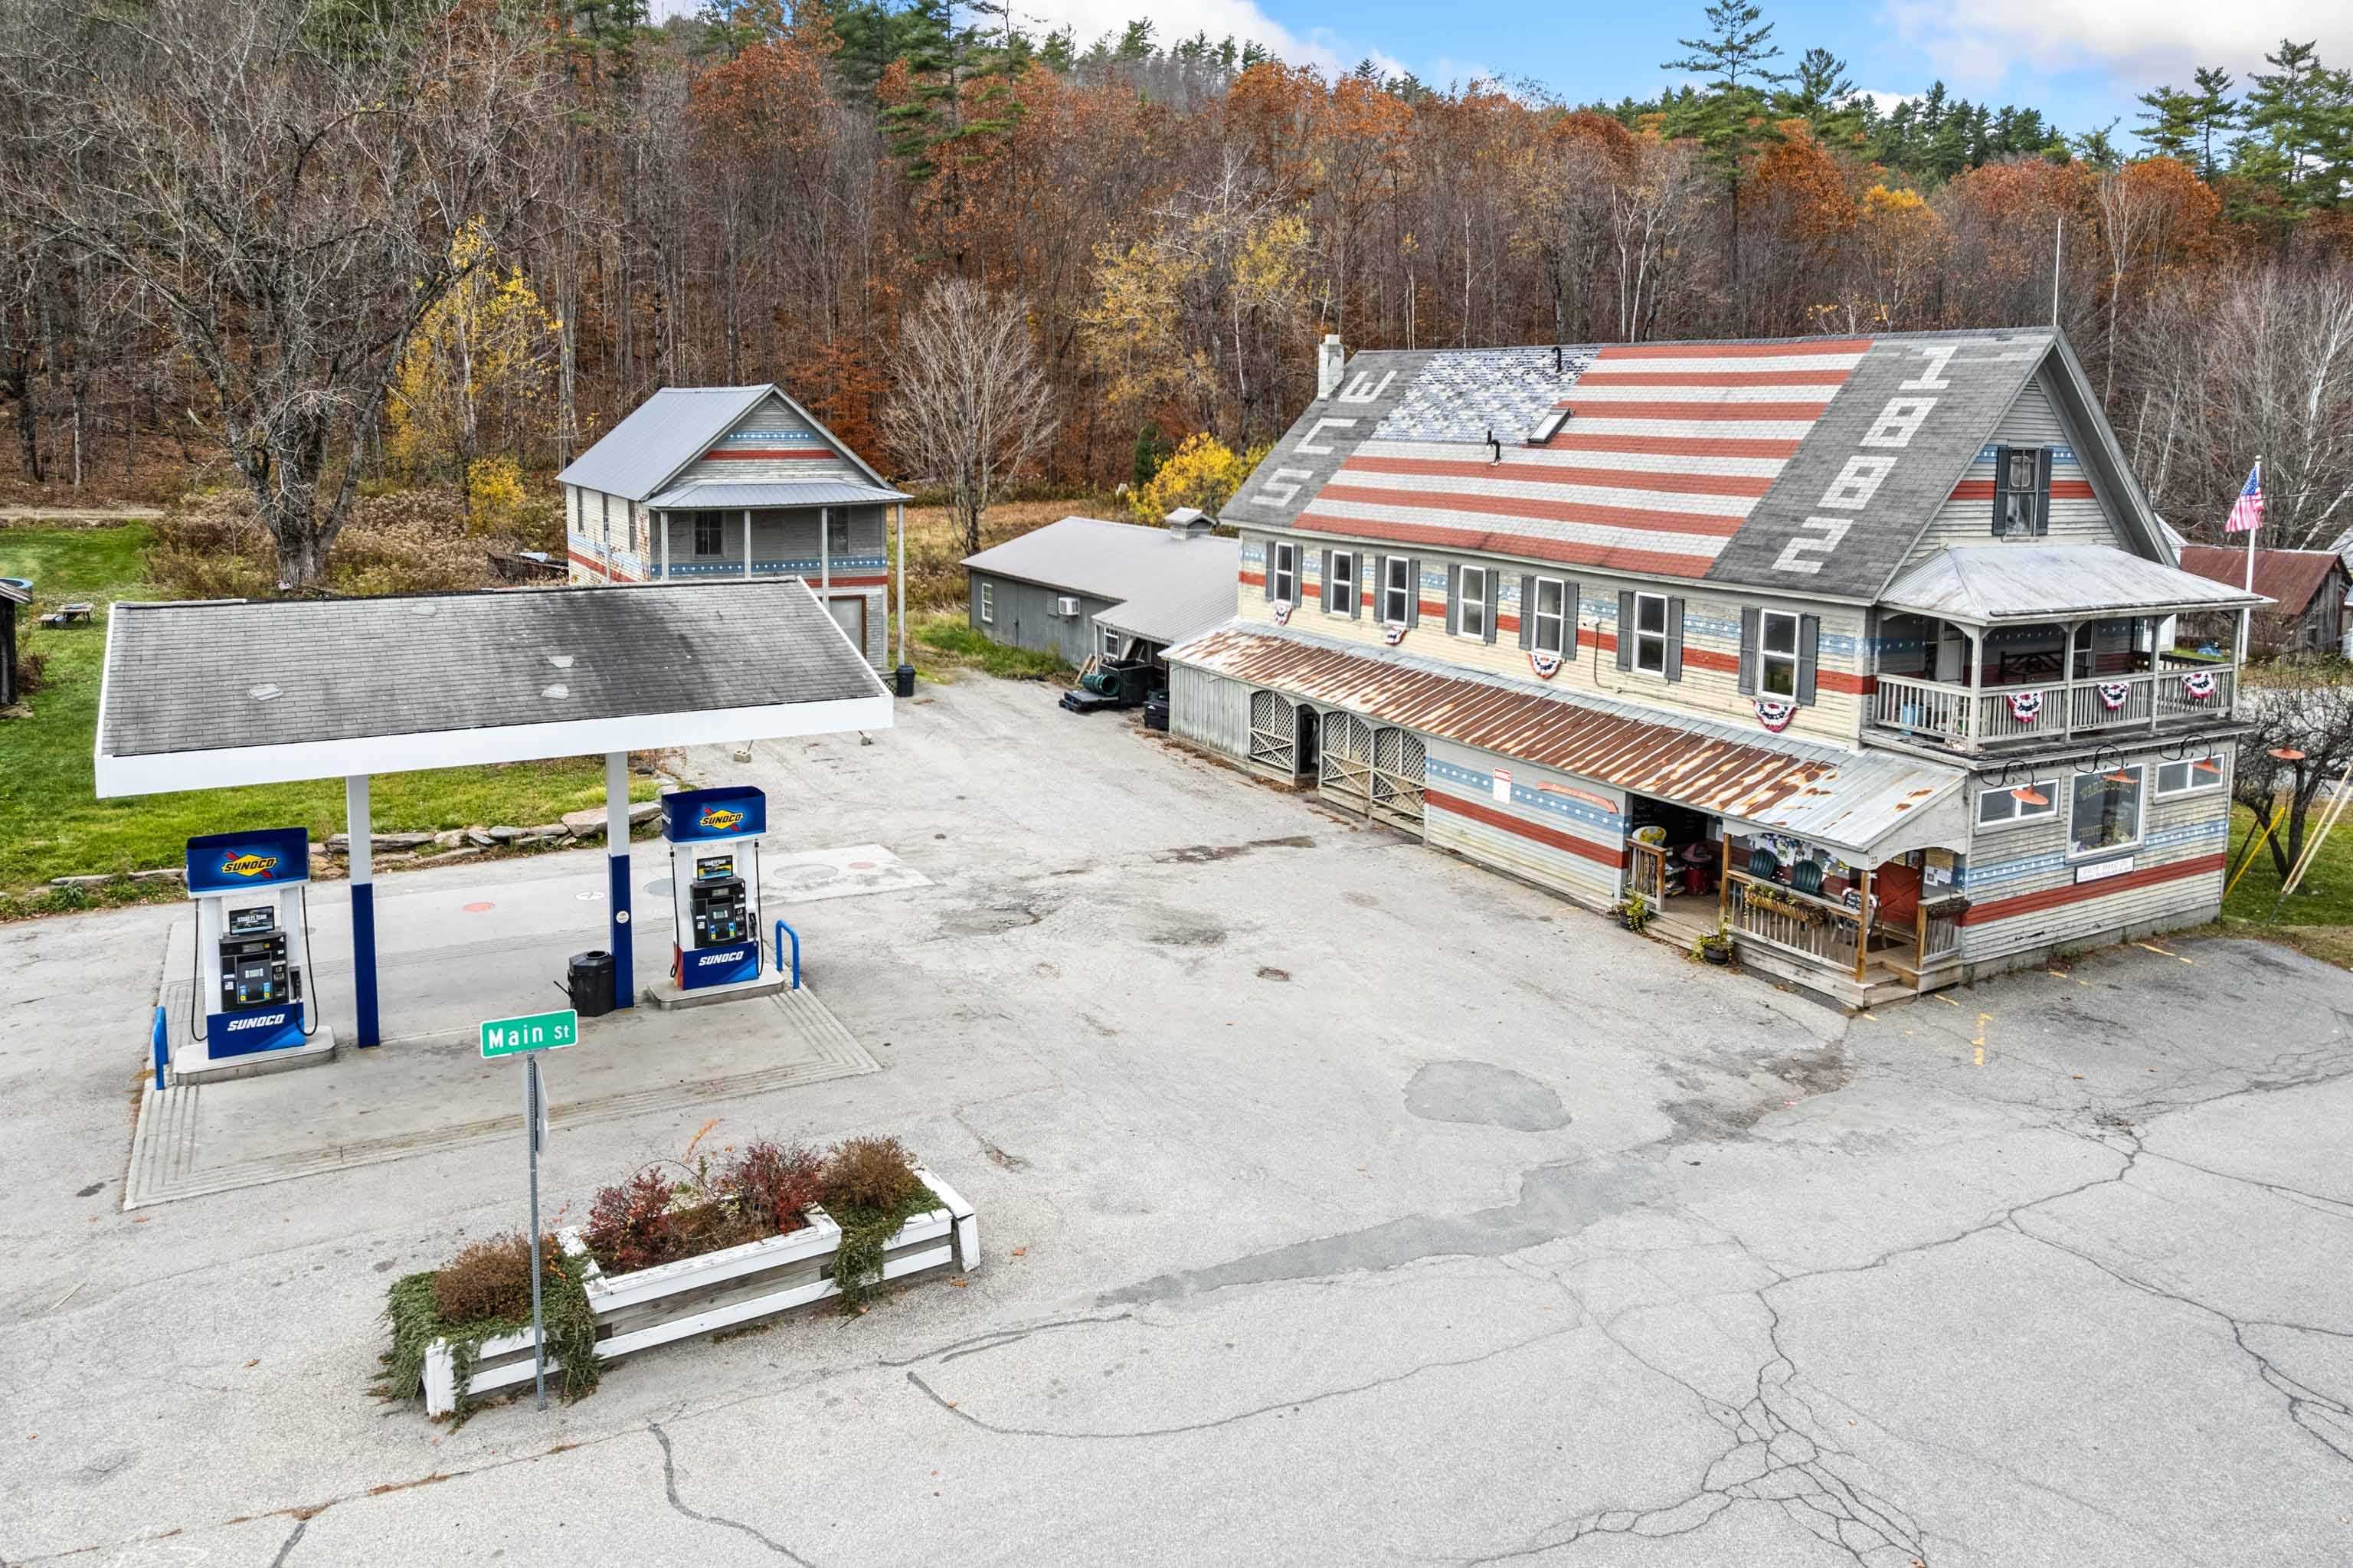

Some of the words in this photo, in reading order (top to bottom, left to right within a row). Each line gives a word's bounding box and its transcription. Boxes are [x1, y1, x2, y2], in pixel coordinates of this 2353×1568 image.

[702, 813, 742, 825] SUNOCO
[224, 858, 275, 872] SUNOCO
[699, 951, 744, 967] SUNOCO
[227, 1013, 286, 1032] SUNOCO
[488, 1024, 544, 1049] Main
[554, 1025, 570, 1039] St
